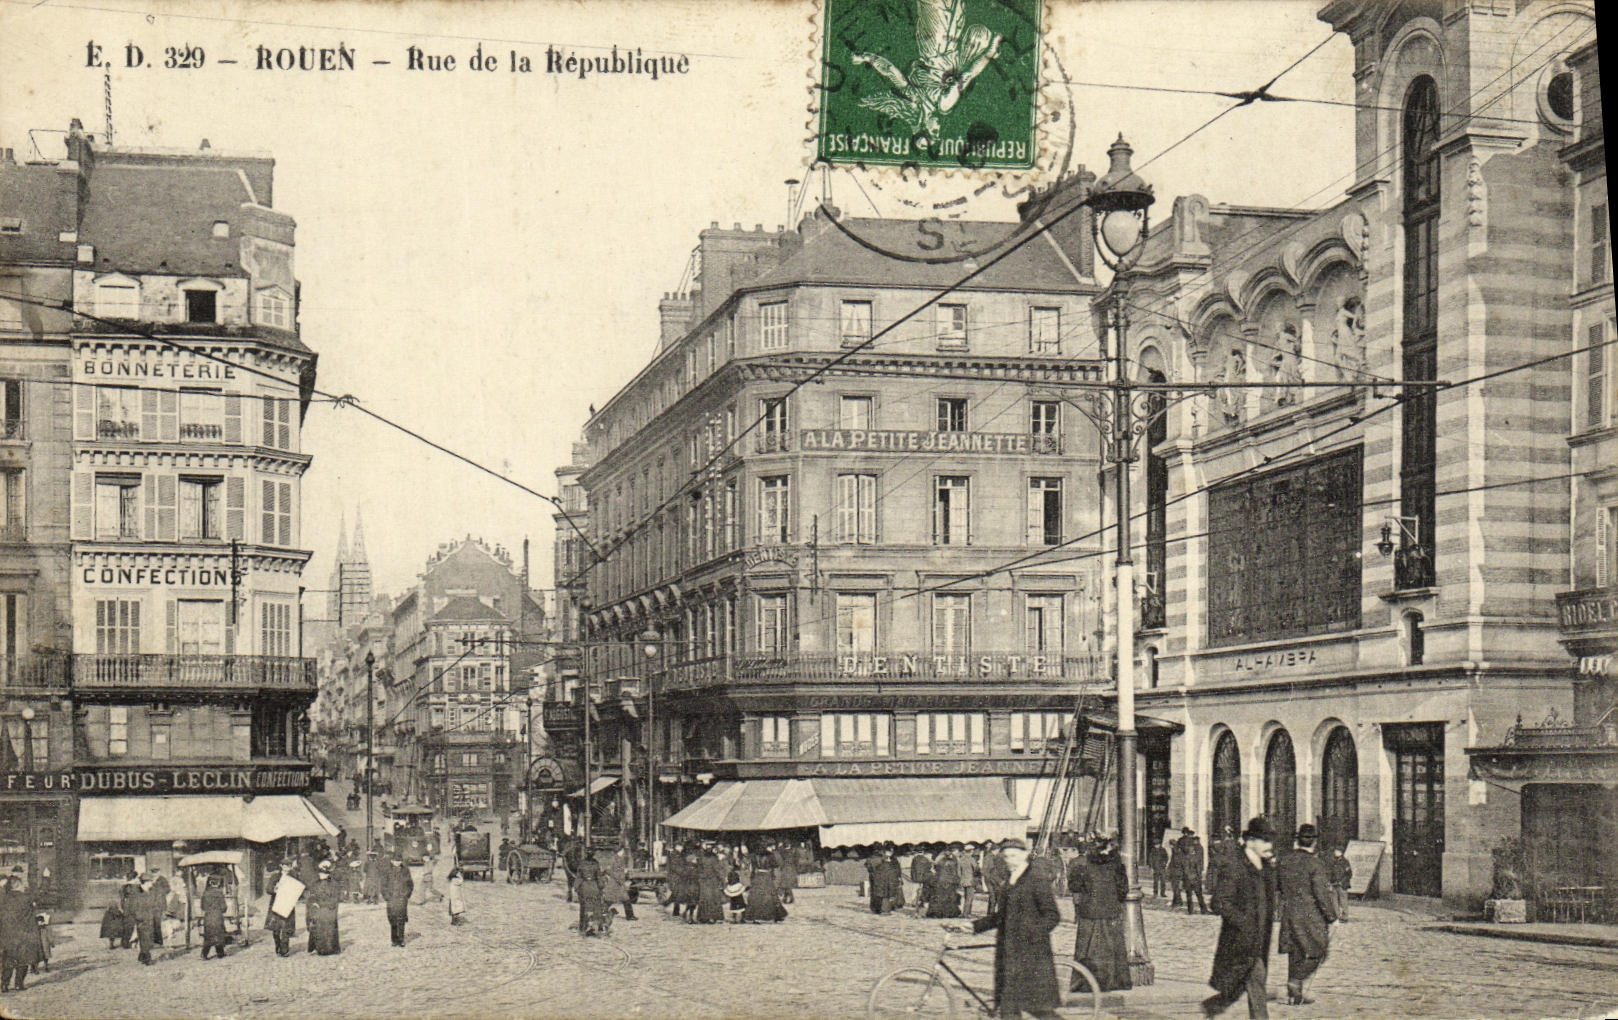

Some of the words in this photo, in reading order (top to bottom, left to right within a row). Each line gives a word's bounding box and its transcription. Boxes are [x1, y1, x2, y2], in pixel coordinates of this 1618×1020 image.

[84, 361, 236, 379] BONNETERIE
[804, 432, 817, 448] A
[822, 432, 844, 448] LA
[849, 431, 919, 449] PETITE
[922, 431, 1027, 451] JEANNETTE
[83, 568, 242, 586] CONFECTIONS
[843, 655, 1047, 675] DENTISTE
[837, 762, 862, 775] LA
[870, 762, 943, 775] PETITE
[255, 770, 310, 788] CONFECTIONS
